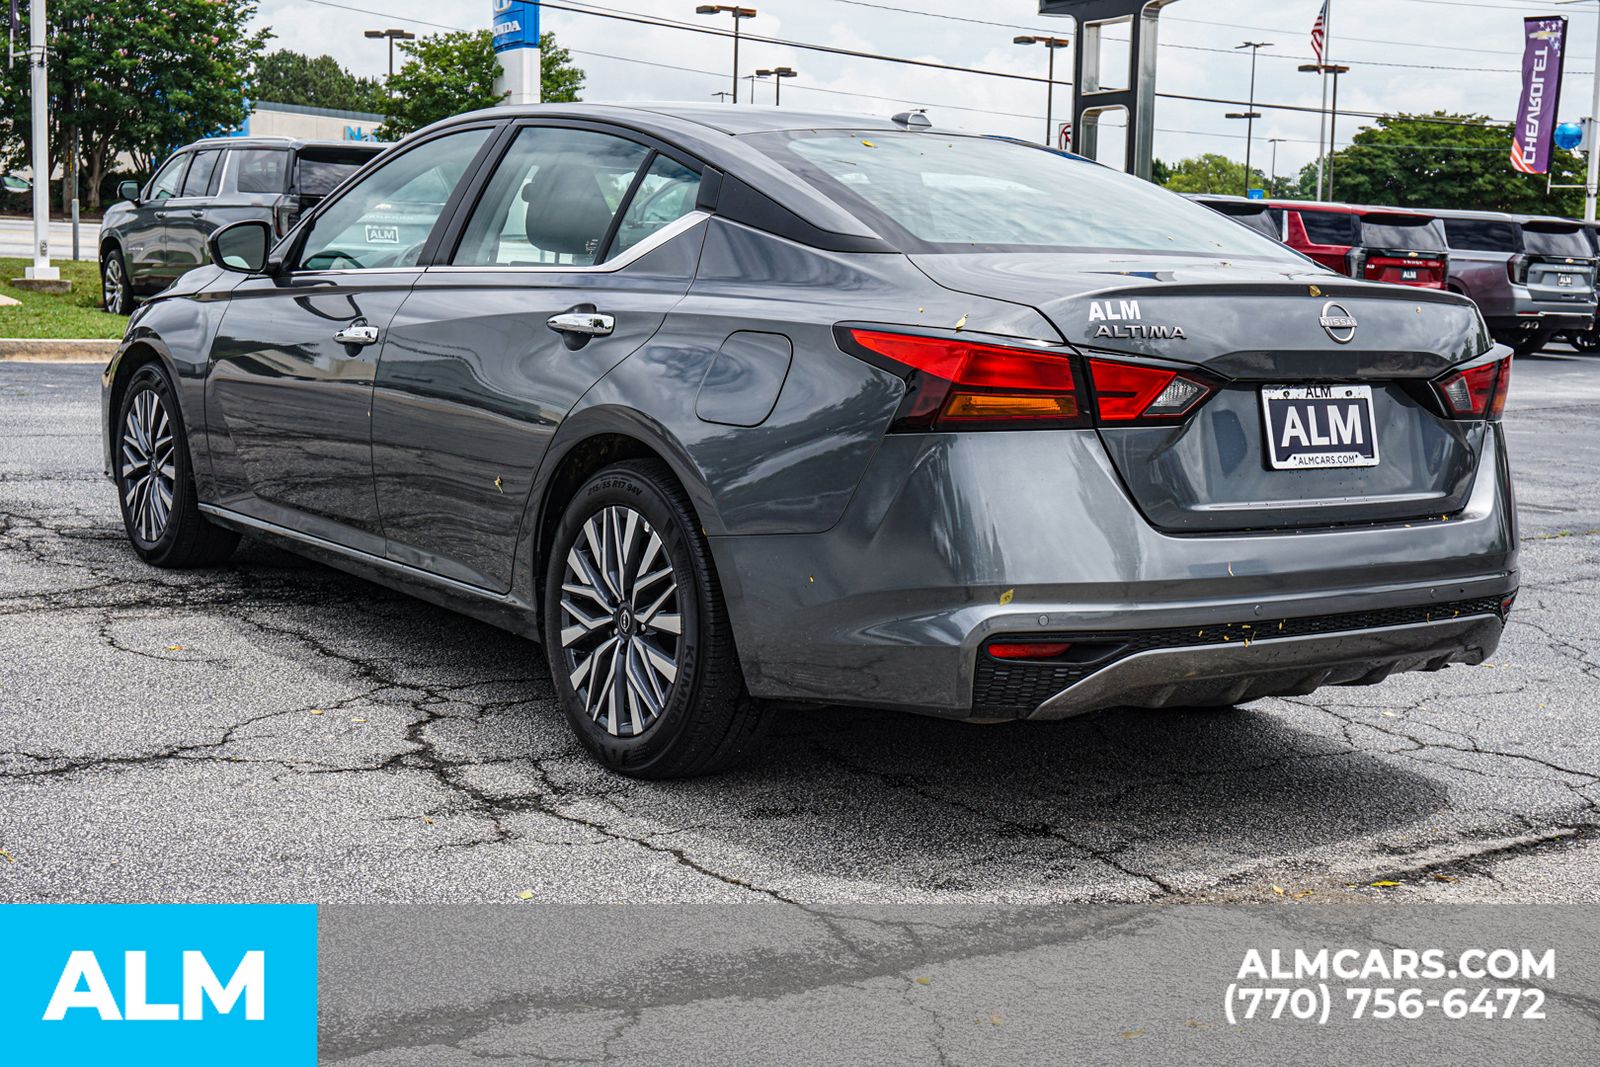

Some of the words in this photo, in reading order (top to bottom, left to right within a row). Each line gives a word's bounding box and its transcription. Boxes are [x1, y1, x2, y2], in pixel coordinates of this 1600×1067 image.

[493, 20, 521, 37] ONDA
[370, 230, 395, 239] ALM
[1402, 271, 1417, 279] ALM
[1088, 300, 1141, 321] ALM
[1320, 318, 1357, 326] NISSAN
[1093, 324, 1187, 339] ALTIMA
[1305, 386, 1332, 398] ALM
[1281, 404, 1363, 447] ALM
[1298, 455, 1355, 465] ALMCARS.COM
[612, 480, 626, 489] R17
[626, 483, 643, 496] 94V
[669, 645, 695, 723] KUMHO
